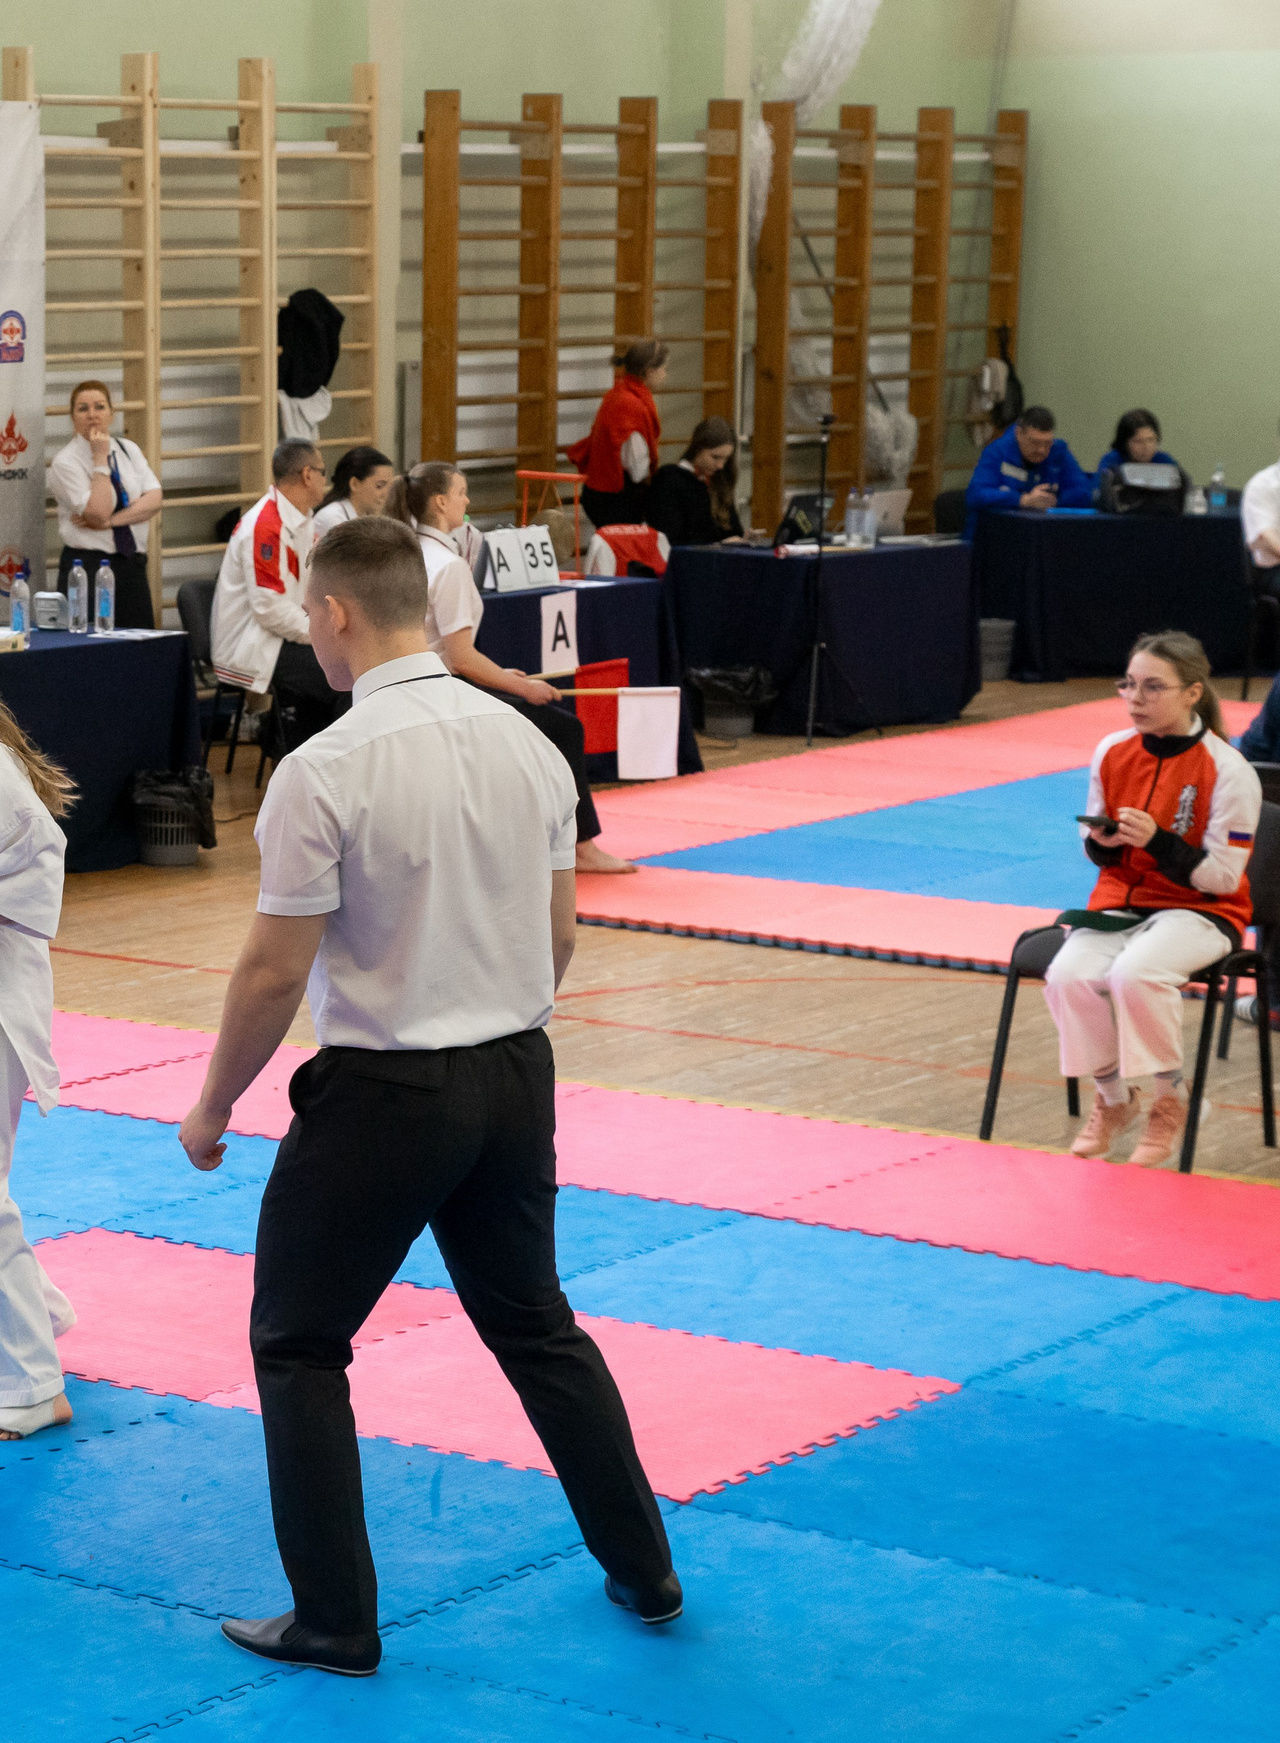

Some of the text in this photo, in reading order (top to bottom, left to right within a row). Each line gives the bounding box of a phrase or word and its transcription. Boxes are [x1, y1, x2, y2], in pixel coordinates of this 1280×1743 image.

[497, 541, 554, 573] A 35
[551, 610, 570, 653] A
